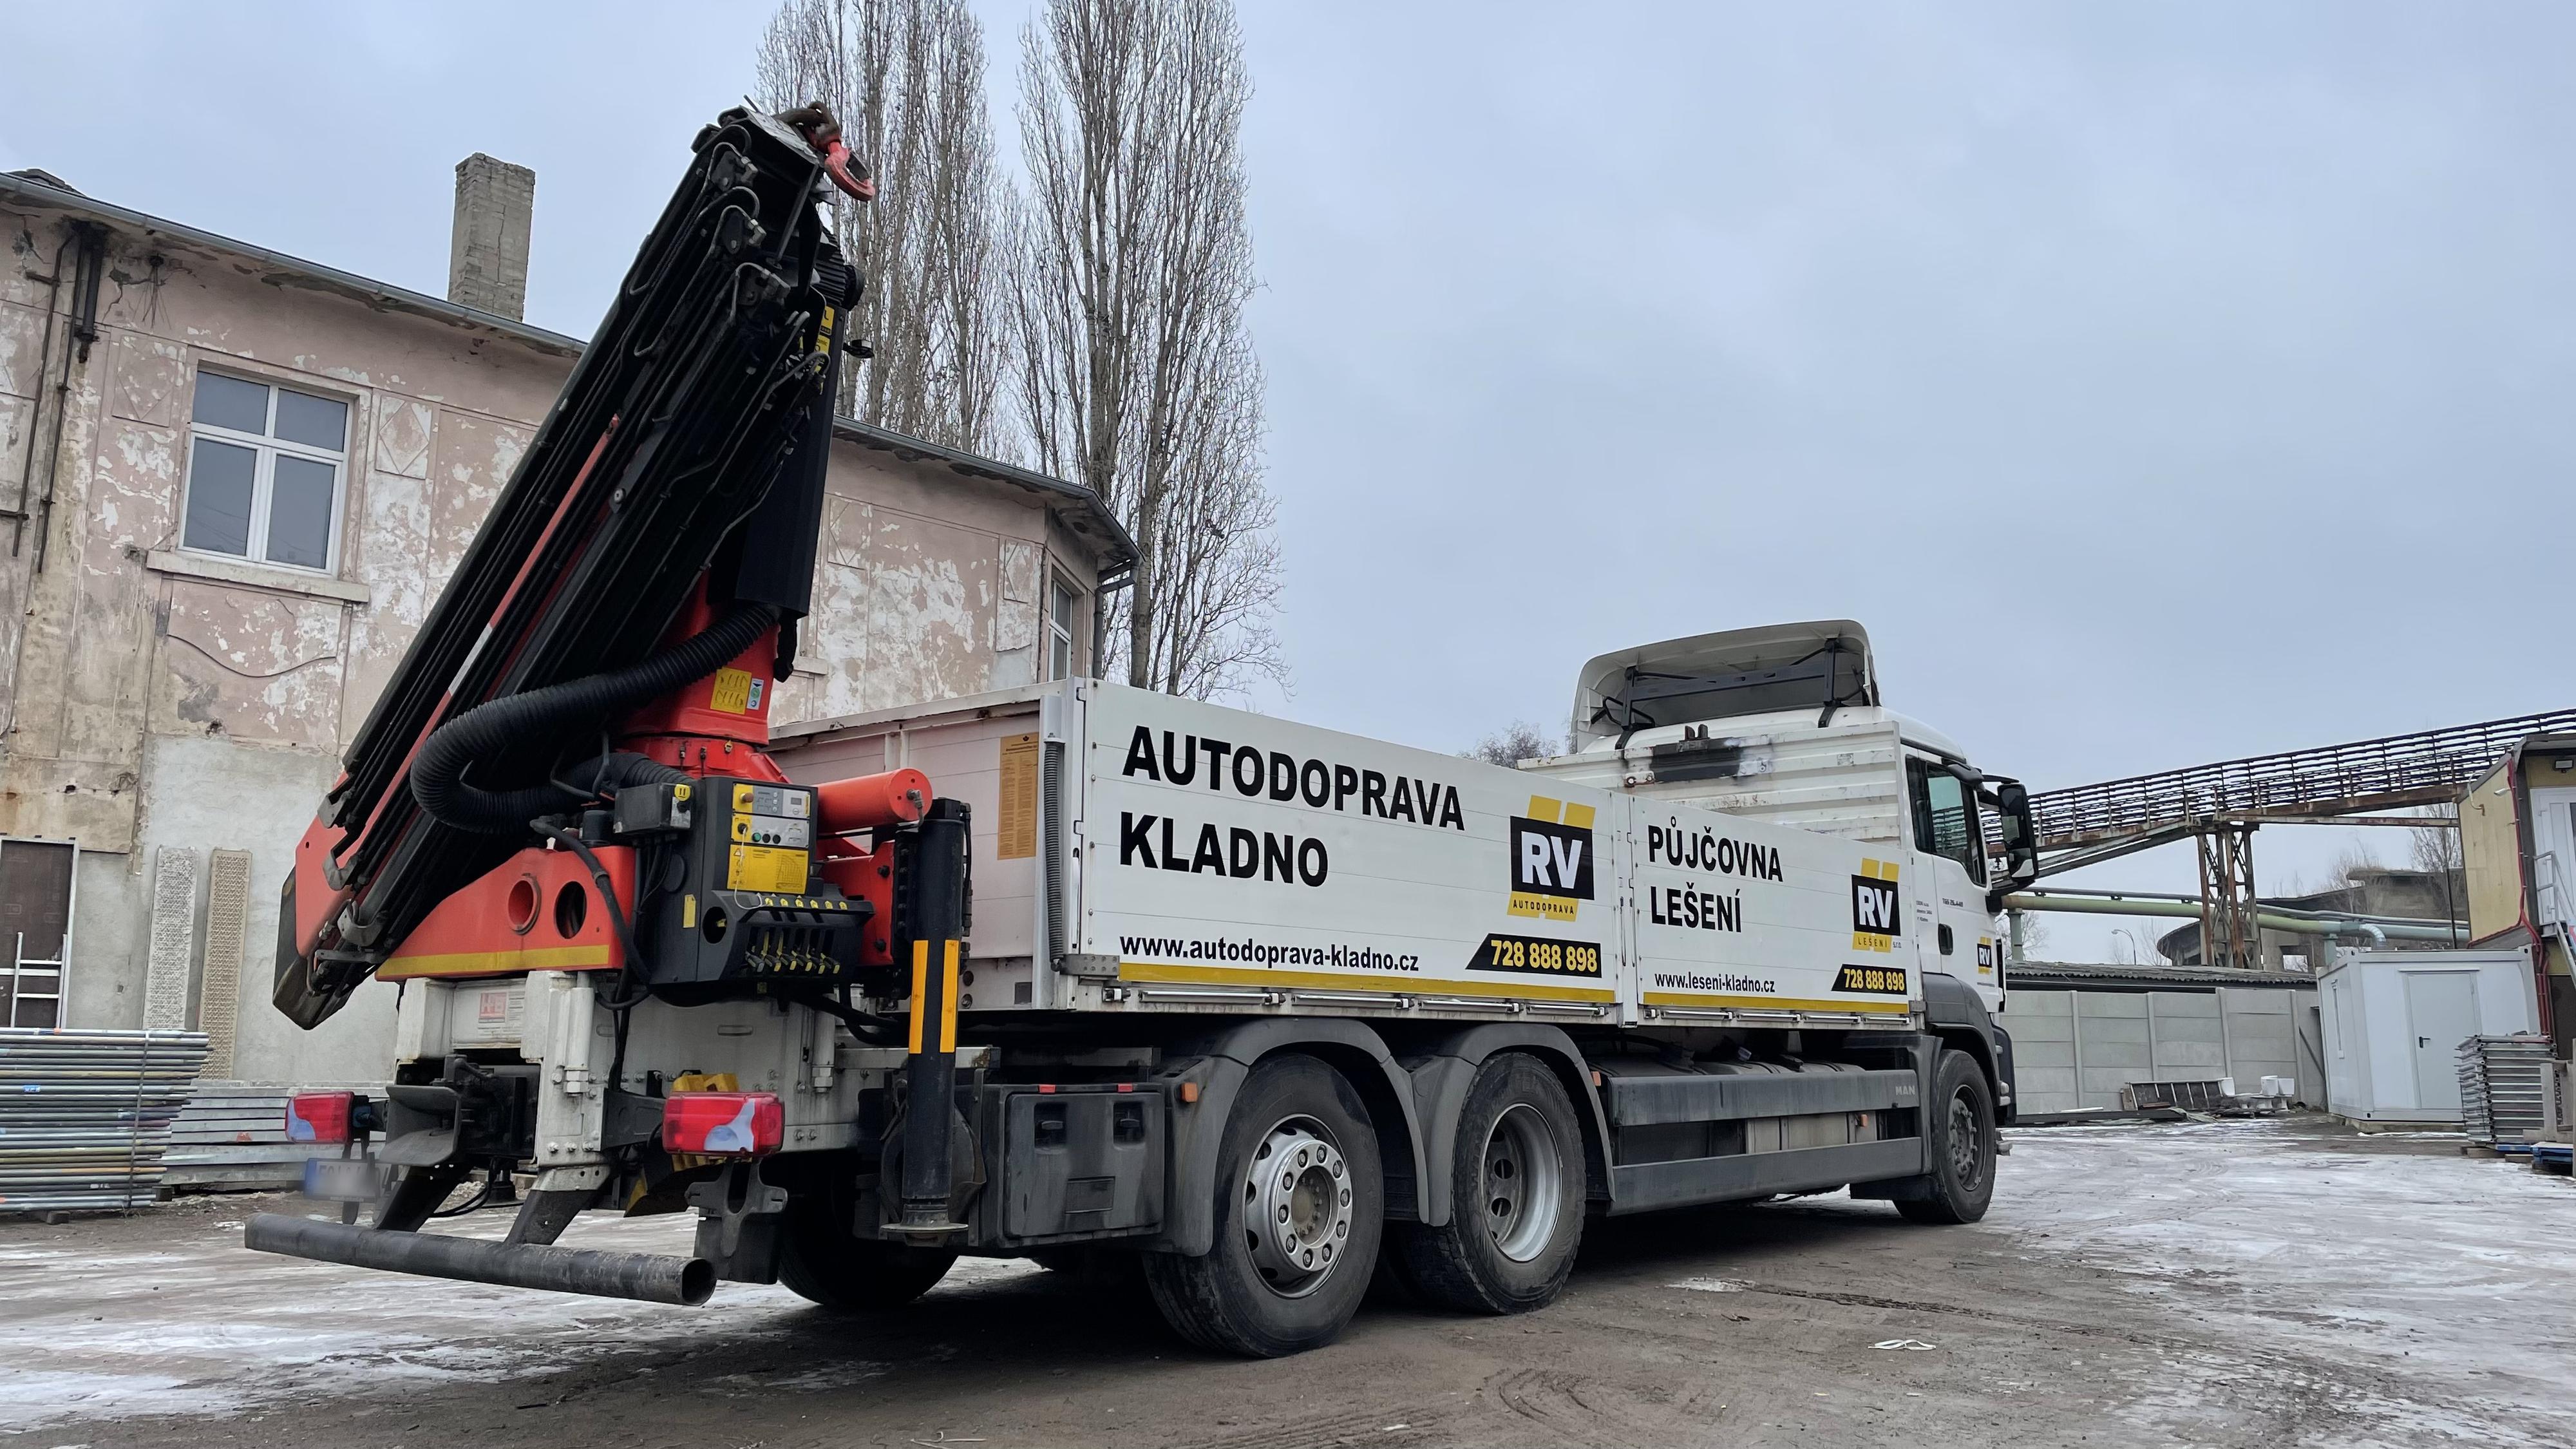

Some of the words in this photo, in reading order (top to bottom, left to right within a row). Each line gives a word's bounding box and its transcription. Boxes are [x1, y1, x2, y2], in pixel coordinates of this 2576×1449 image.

[1122, 726, 1464, 831] AUTODOPRAVA
[1121, 811, 1328, 887] KLADNO
[1521, 831, 1582, 889] RV
[1648, 816, 1783, 882] PŮJČOVNA
[1513, 900, 1574, 914] AUTODOPRAVA
[1651, 882, 1741, 933] LEŠENÍ
[1858, 886, 1893, 928] RV
[1119, 936, 1419, 971] www.autodoprava-kladno.cz
[1491, 940, 1525, 967] 728
[1529, 943, 1562, 970] 888
[1566, 945, 1598, 972] 898
[1979, 948, 1990, 965] RV
[1655, 972, 1776, 992] www.leseni-kladno.cz
[1844, 969, 1864, 989] 728
[1866, 971, 1884, 990] 888
[1886, 972, 1904, 990] 898
[1895, 1085, 1915, 1095] MAN
